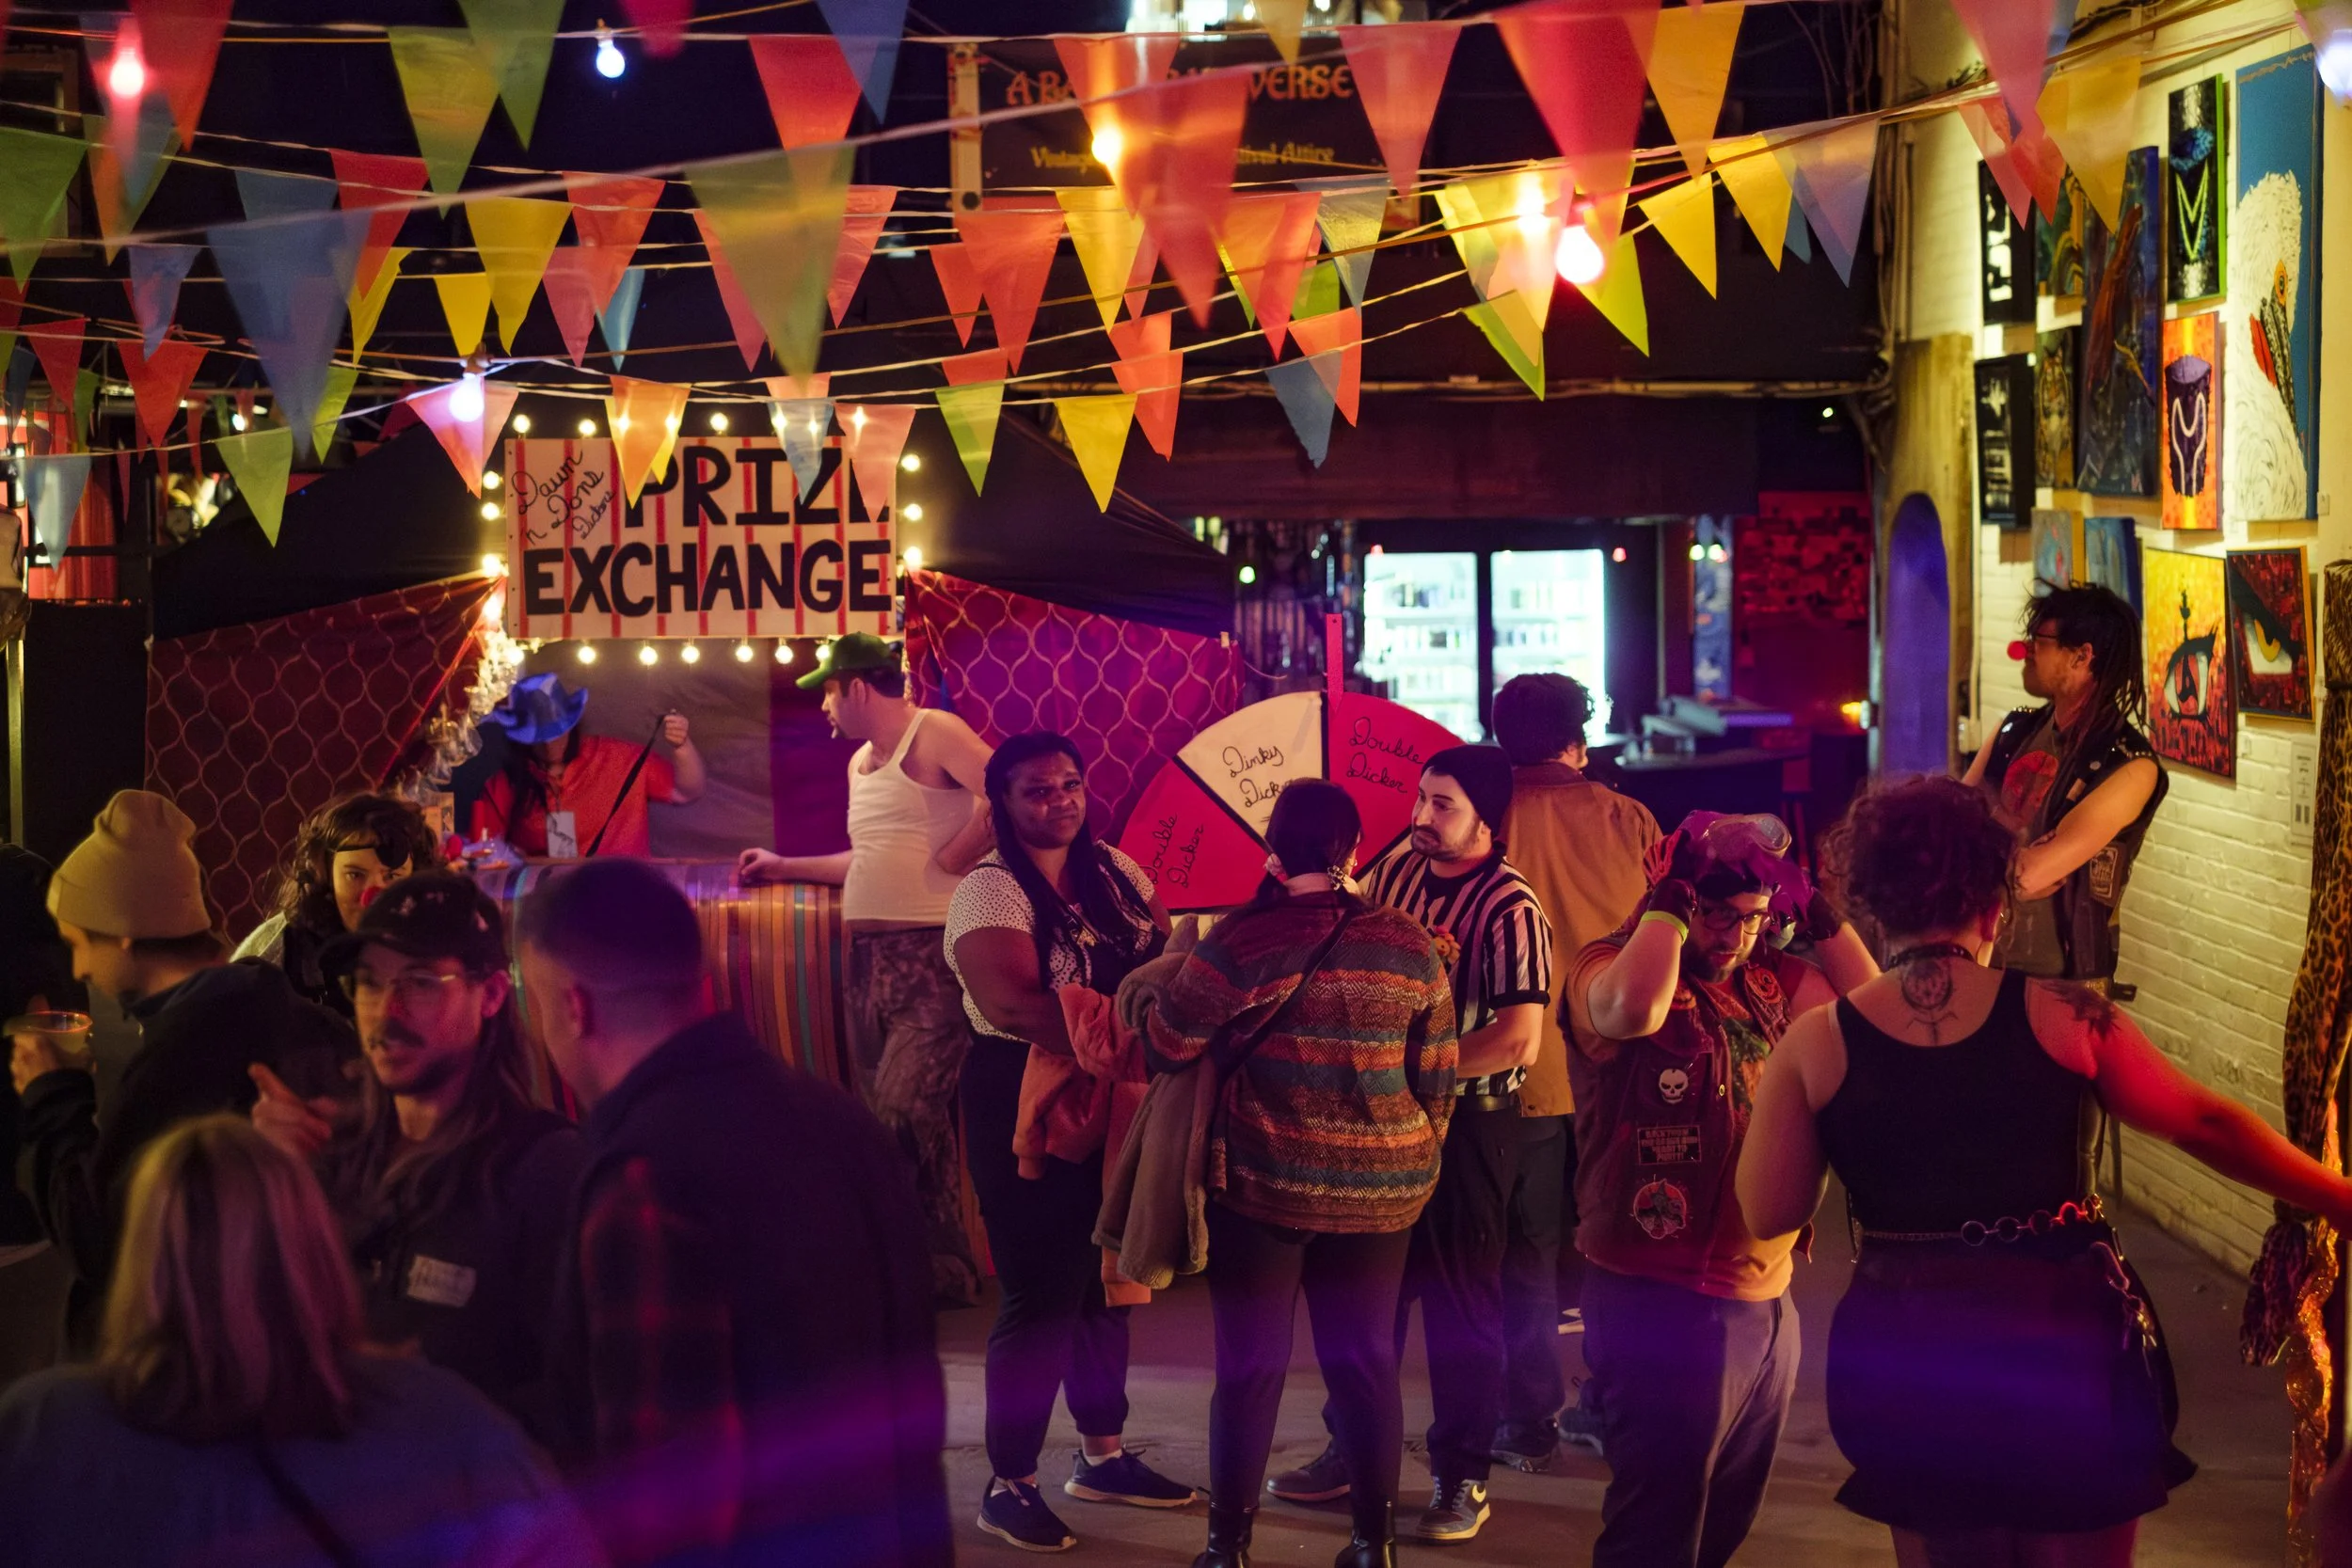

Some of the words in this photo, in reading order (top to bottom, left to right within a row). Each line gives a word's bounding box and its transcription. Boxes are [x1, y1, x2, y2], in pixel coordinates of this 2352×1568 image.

[511, 451, 583, 515] Dawn
[547, 470, 604, 530] Dons
[522, 539, 893, 618] EXCHANGE
[1222, 745, 1284, 779] Dinky
[1348, 716, 1424, 765] Double
[1239, 778, 1292, 808] Dick
[1346, 752, 1408, 794] Dicker
[1167, 824, 1204, 888] Dicker
